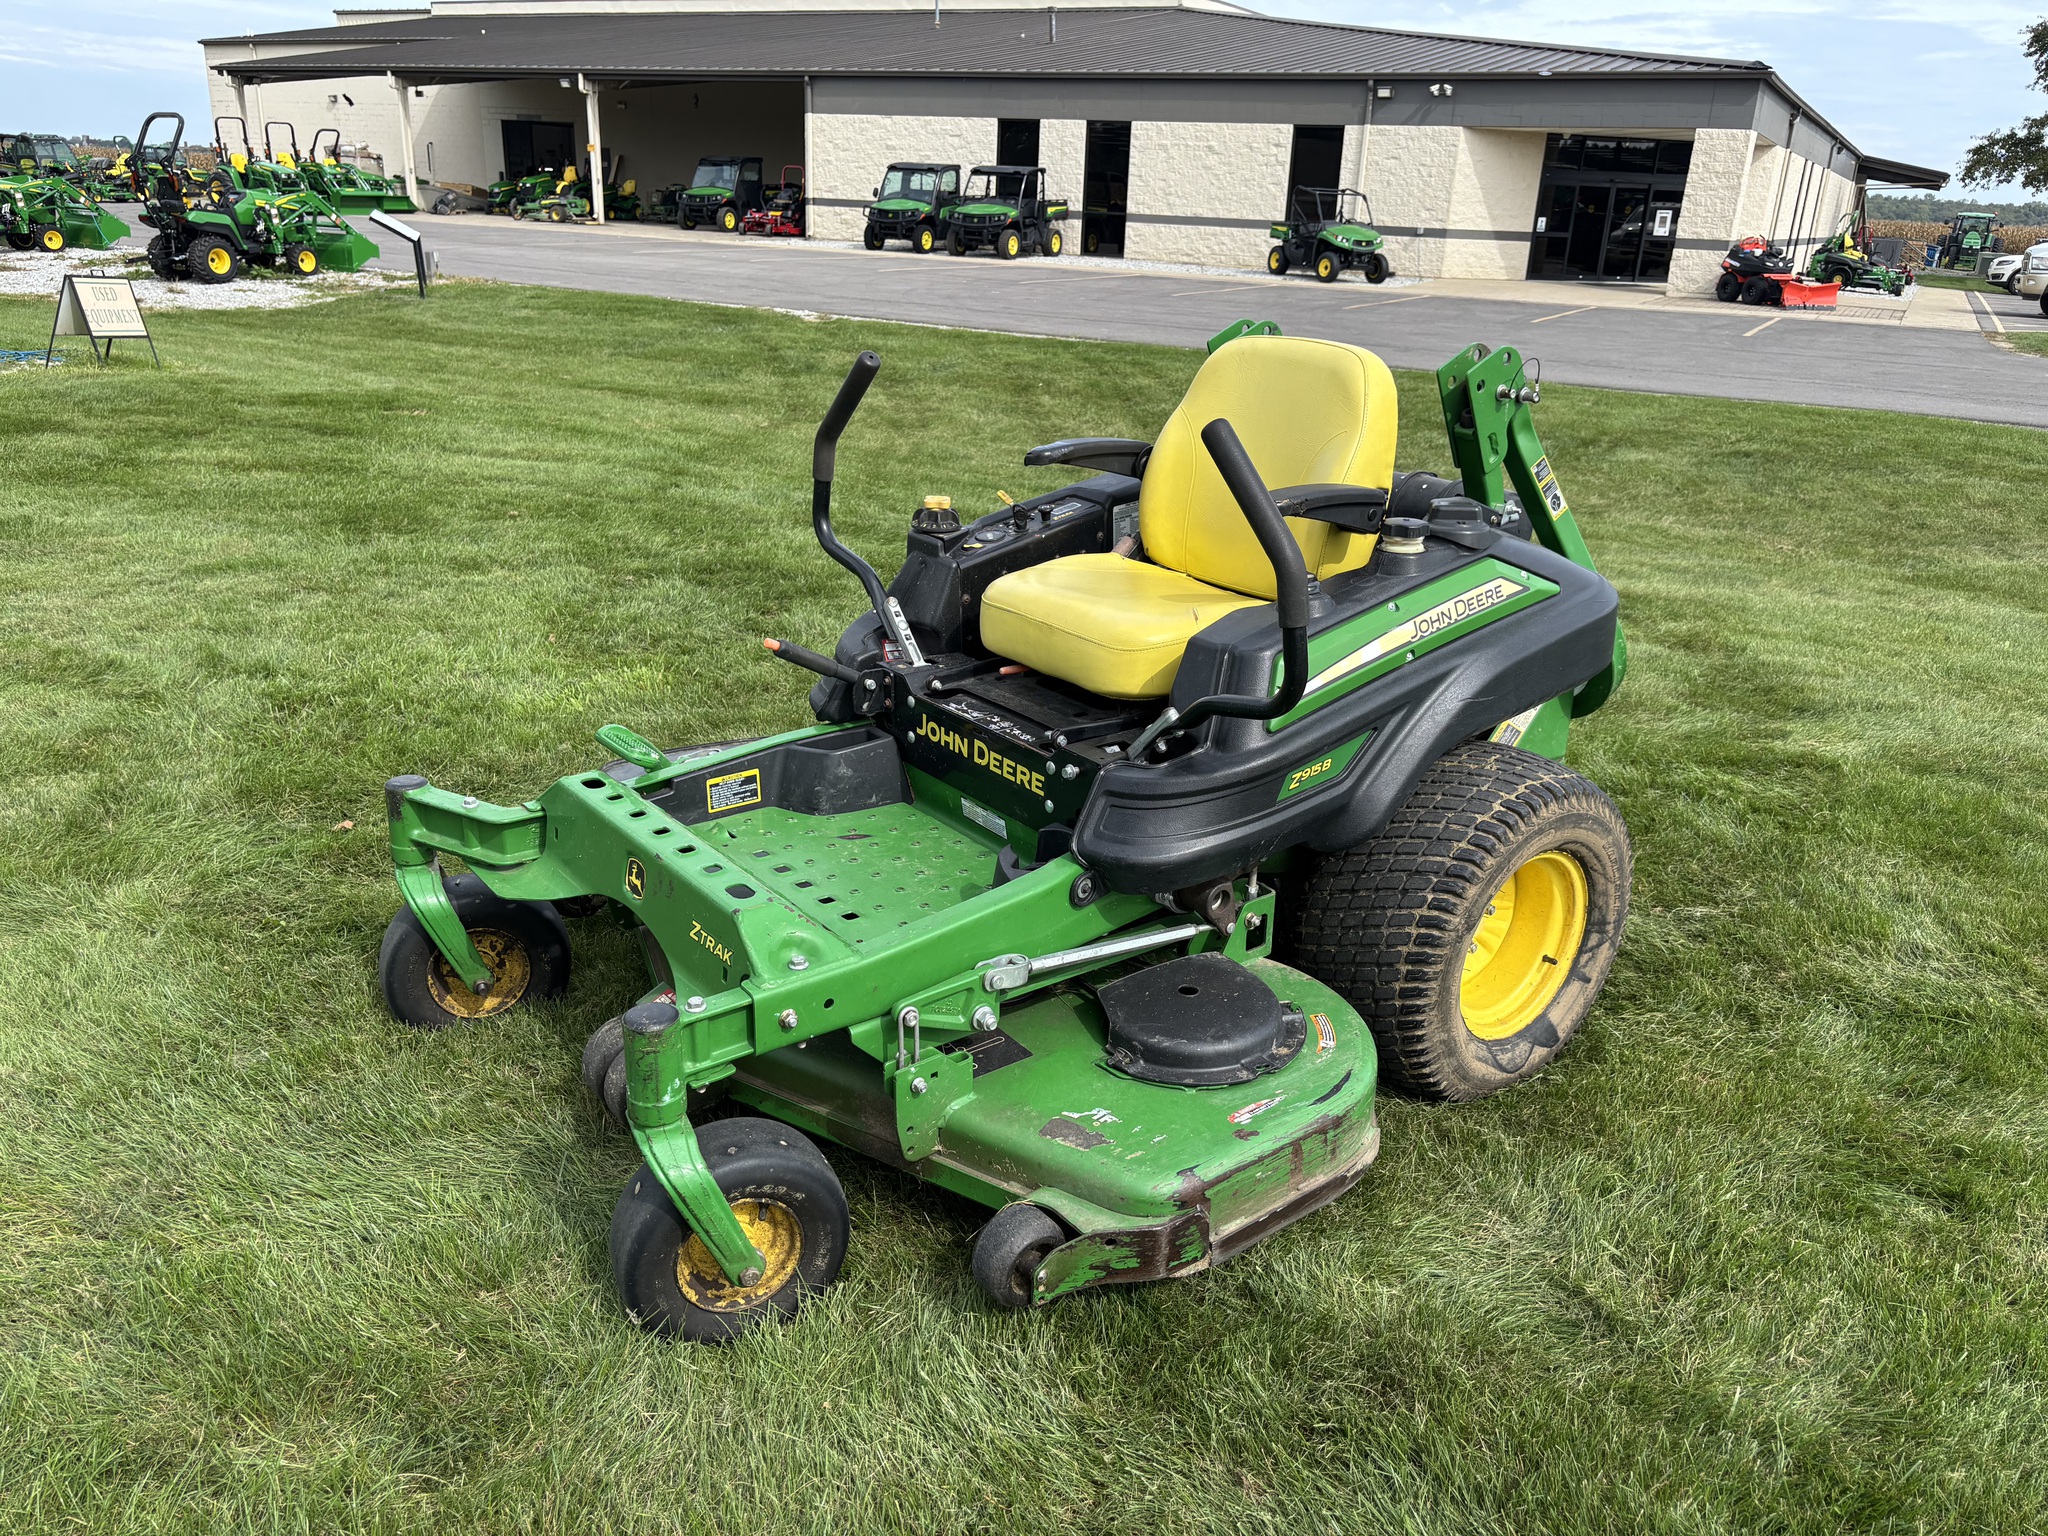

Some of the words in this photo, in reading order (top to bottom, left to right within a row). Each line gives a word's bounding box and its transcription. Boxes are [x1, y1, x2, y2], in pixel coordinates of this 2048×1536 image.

[91, 286, 118, 302] USED
[84, 308, 140, 328] EQUIPMENT
[1410, 608, 1453, 640] JOHN
[1453, 584, 1505, 618] DEERE
[916, 713, 969, 759] JOHN
[973, 738, 1045, 797] DEERE
[1288, 757, 1333, 790] Z915B
[689, 918, 734, 966] ZTRAK
